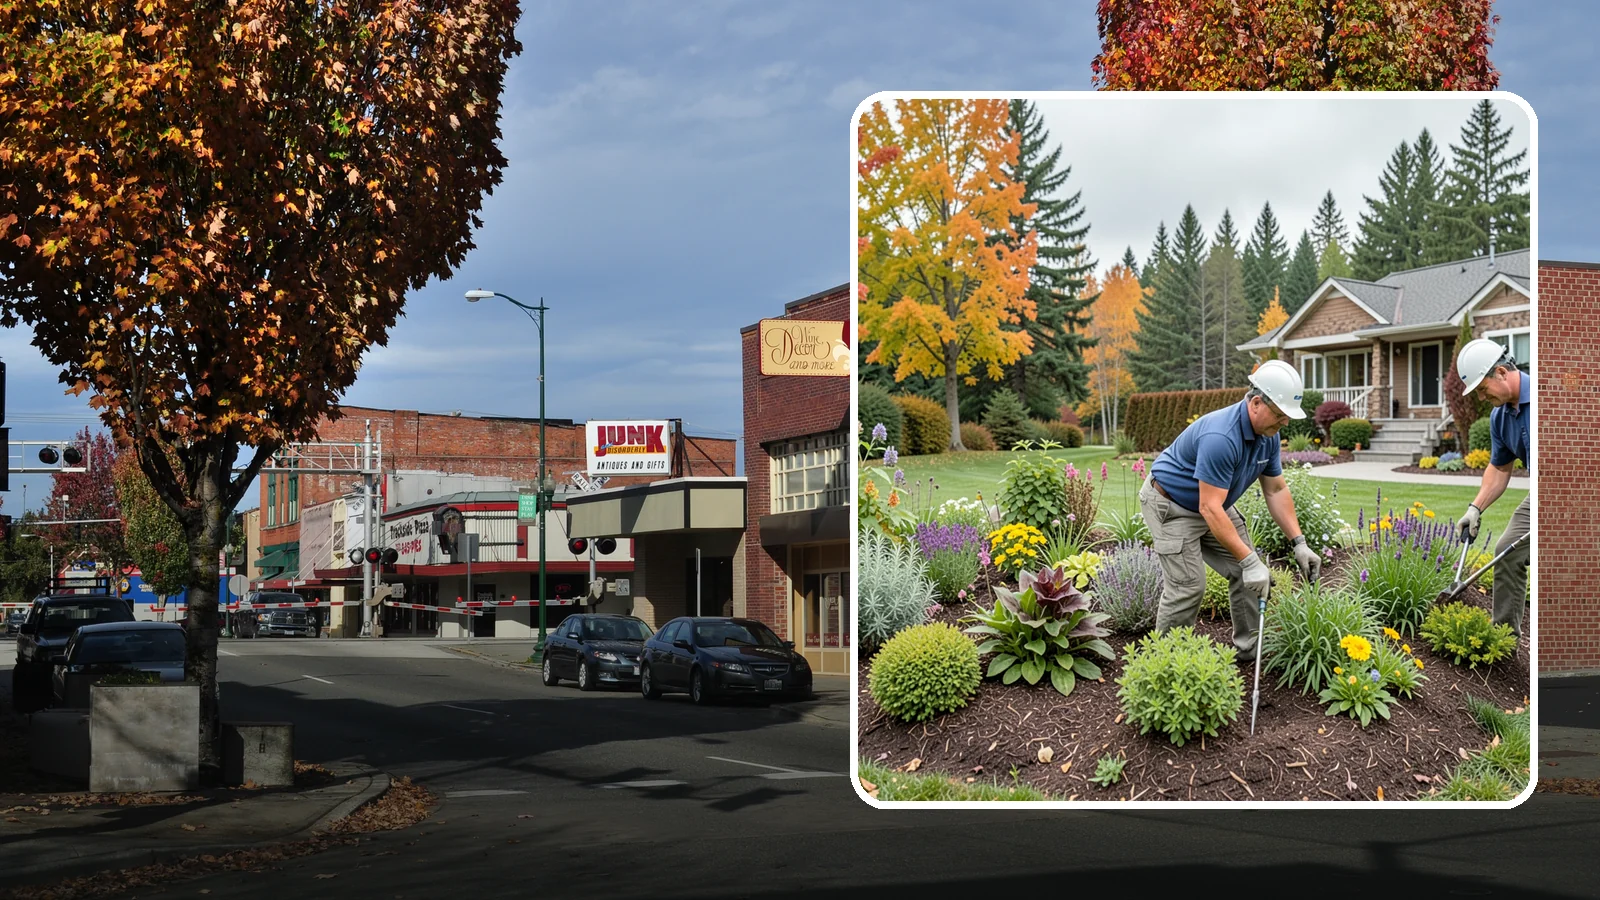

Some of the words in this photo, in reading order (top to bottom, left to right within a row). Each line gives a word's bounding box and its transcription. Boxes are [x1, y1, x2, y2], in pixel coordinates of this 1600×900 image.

[596, 425, 664, 457] JUNK
[607, 446, 646, 454] DISORDERLY
[597, 461, 628, 470] ANTIQUES
[631, 461, 644, 470] AND
[647, 460, 665, 470] GIFTS
[573, 473, 588, 491] RAIL
[353, 498, 365, 510] CRO
[390, 521, 413, 540] Trackside
[415, 519, 429, 535] Pizza
